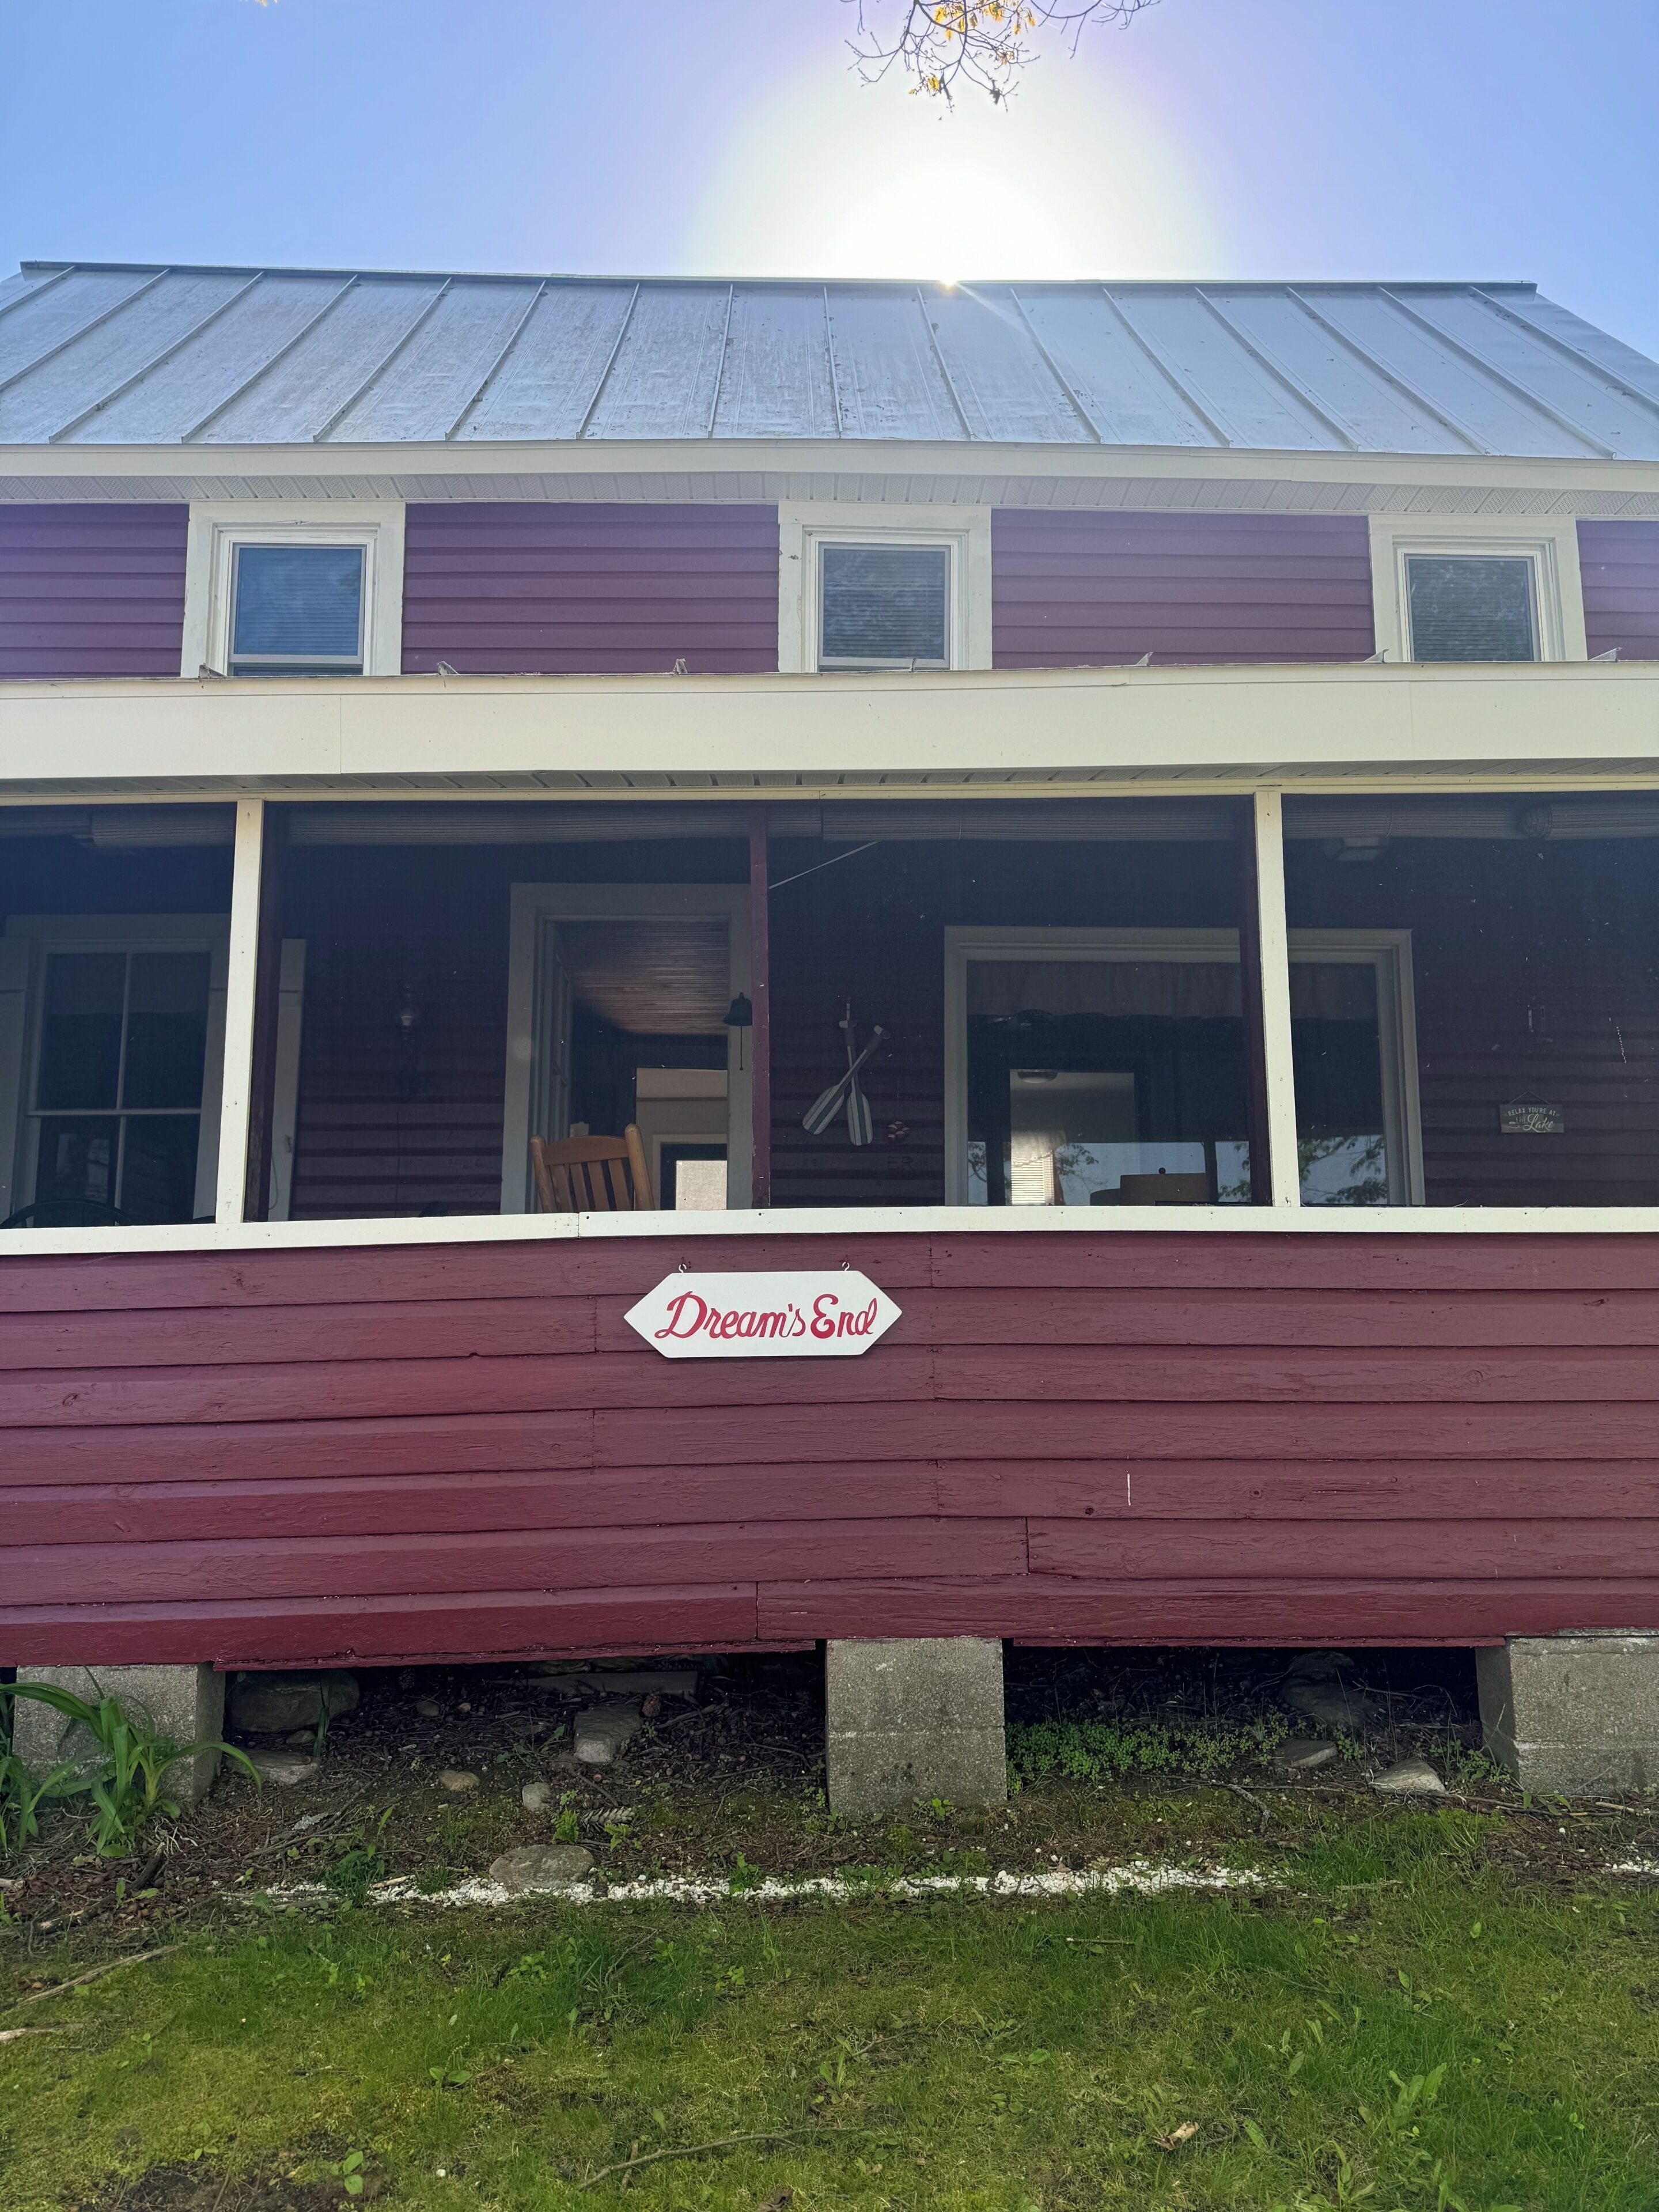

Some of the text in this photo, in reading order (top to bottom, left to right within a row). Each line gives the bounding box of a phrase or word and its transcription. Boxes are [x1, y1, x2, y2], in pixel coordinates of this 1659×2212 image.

[1508, 1107, 1526, 1116] RELAX
[1522, 1113, 1554, 1133] Lake
[654, 1291, 878, 1339] Dream's End
